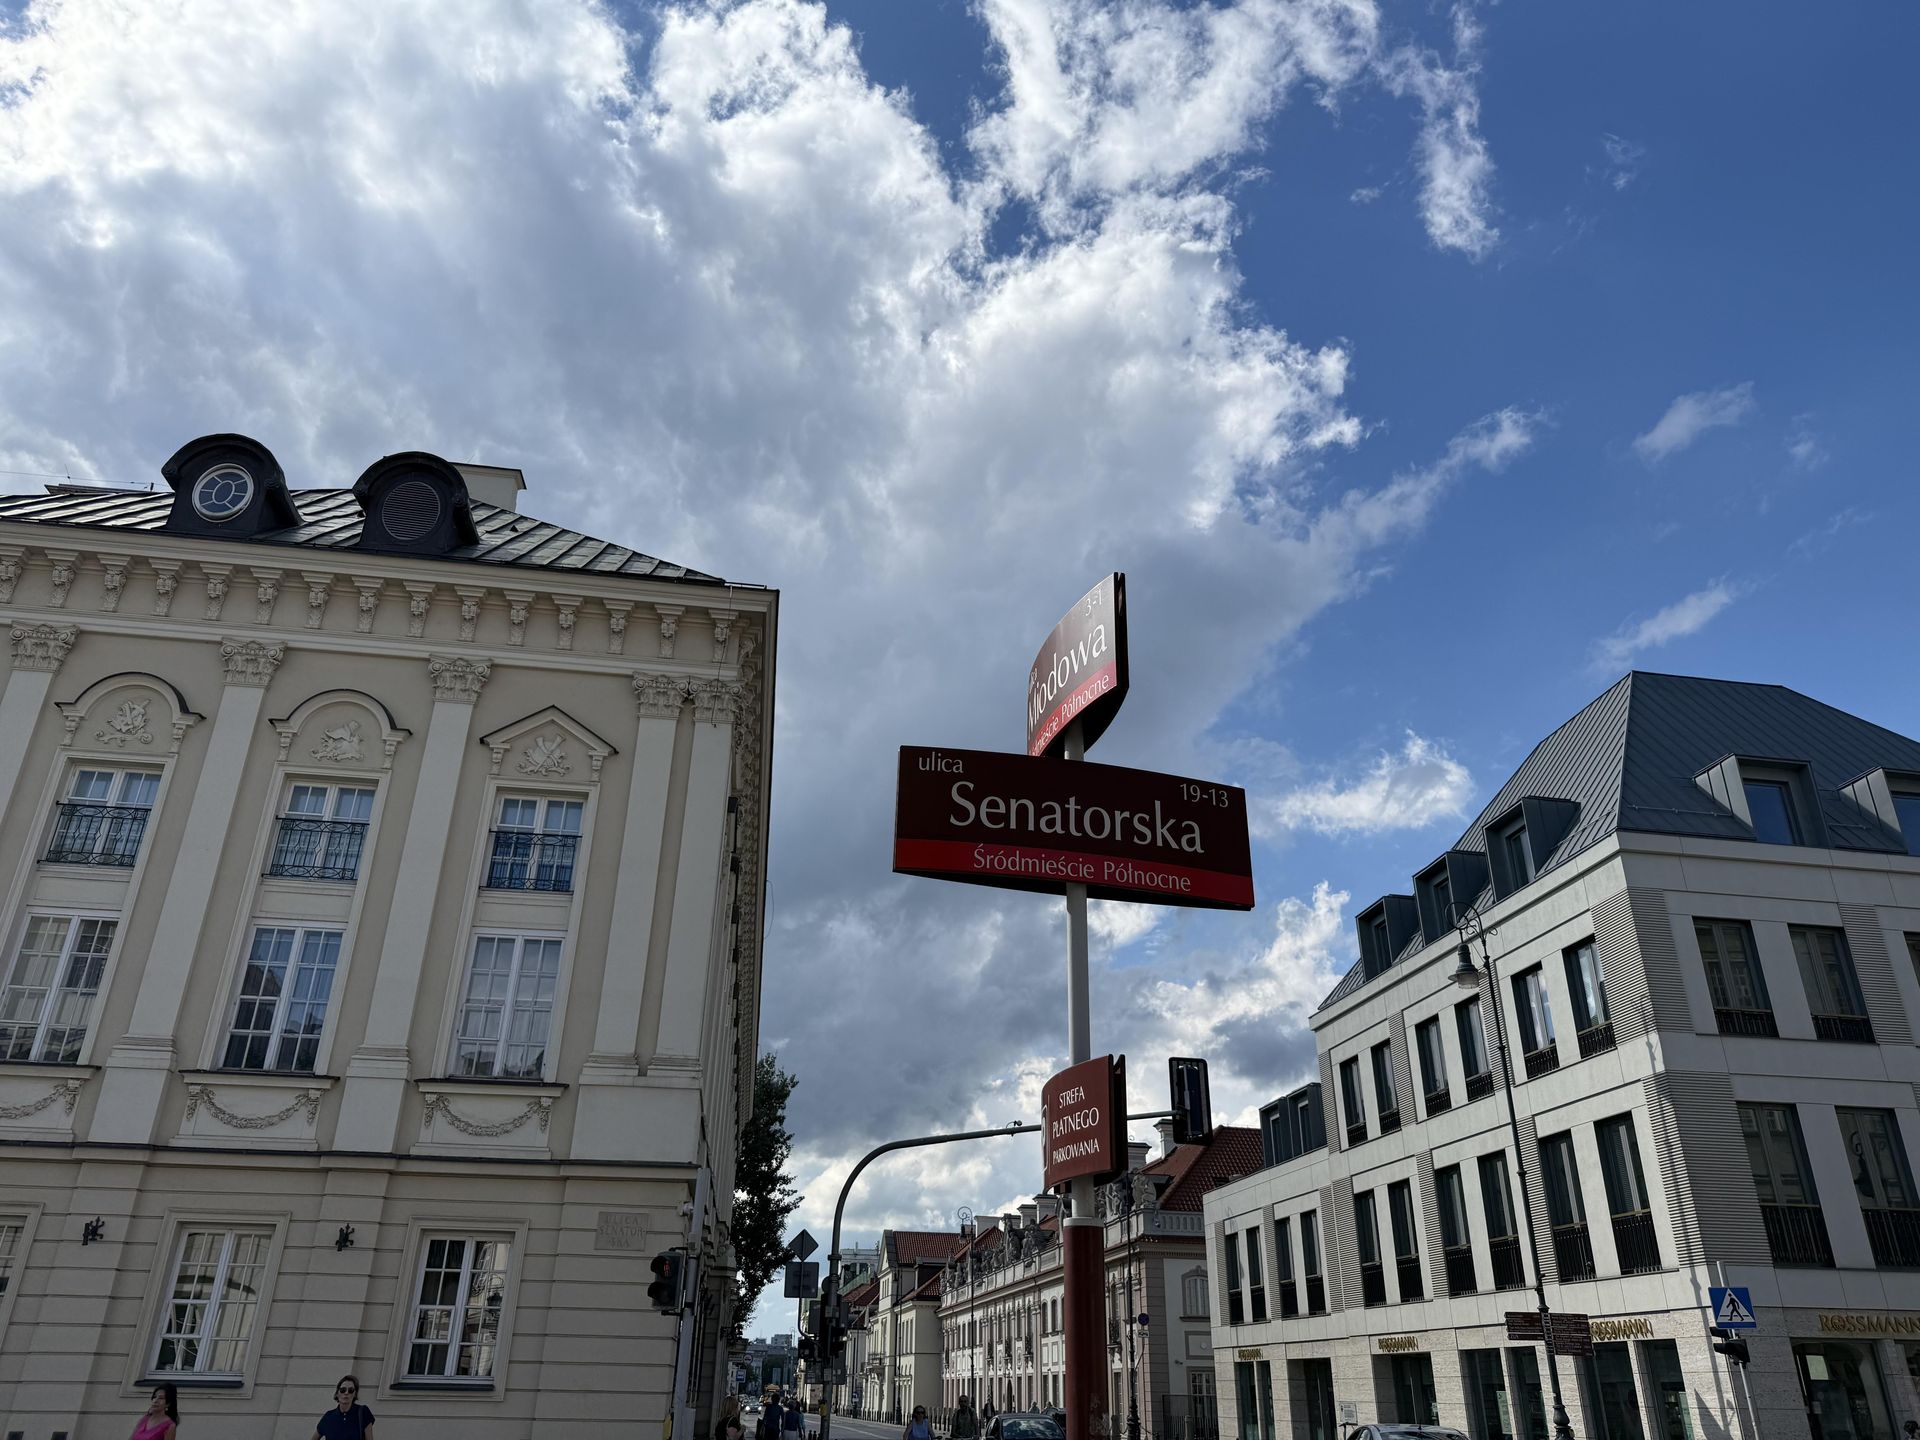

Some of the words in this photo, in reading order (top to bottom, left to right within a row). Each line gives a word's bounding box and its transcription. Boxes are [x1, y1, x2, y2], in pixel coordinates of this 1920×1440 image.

[1085, 589, 1102, 617] 3-1
[1028, 623, 1108, 740] Miodowa
[1061, 674, 1109, 723] Północne
[918, 751, 964, 774] ulica
[1179, 783, 1229, 808] 19-13
[949, 780, 1204, 854] Senatorska
[973, 843, 1095, 879] Śródmieście
[1103, 861, 1191, 892] Północne
[1058, 1086, 1085, 1109] STREFA
[1052, 1107, 1099, 1140] PŁATNEGO
[1052, 1137, 1100, 1166] PARKOWANIA
